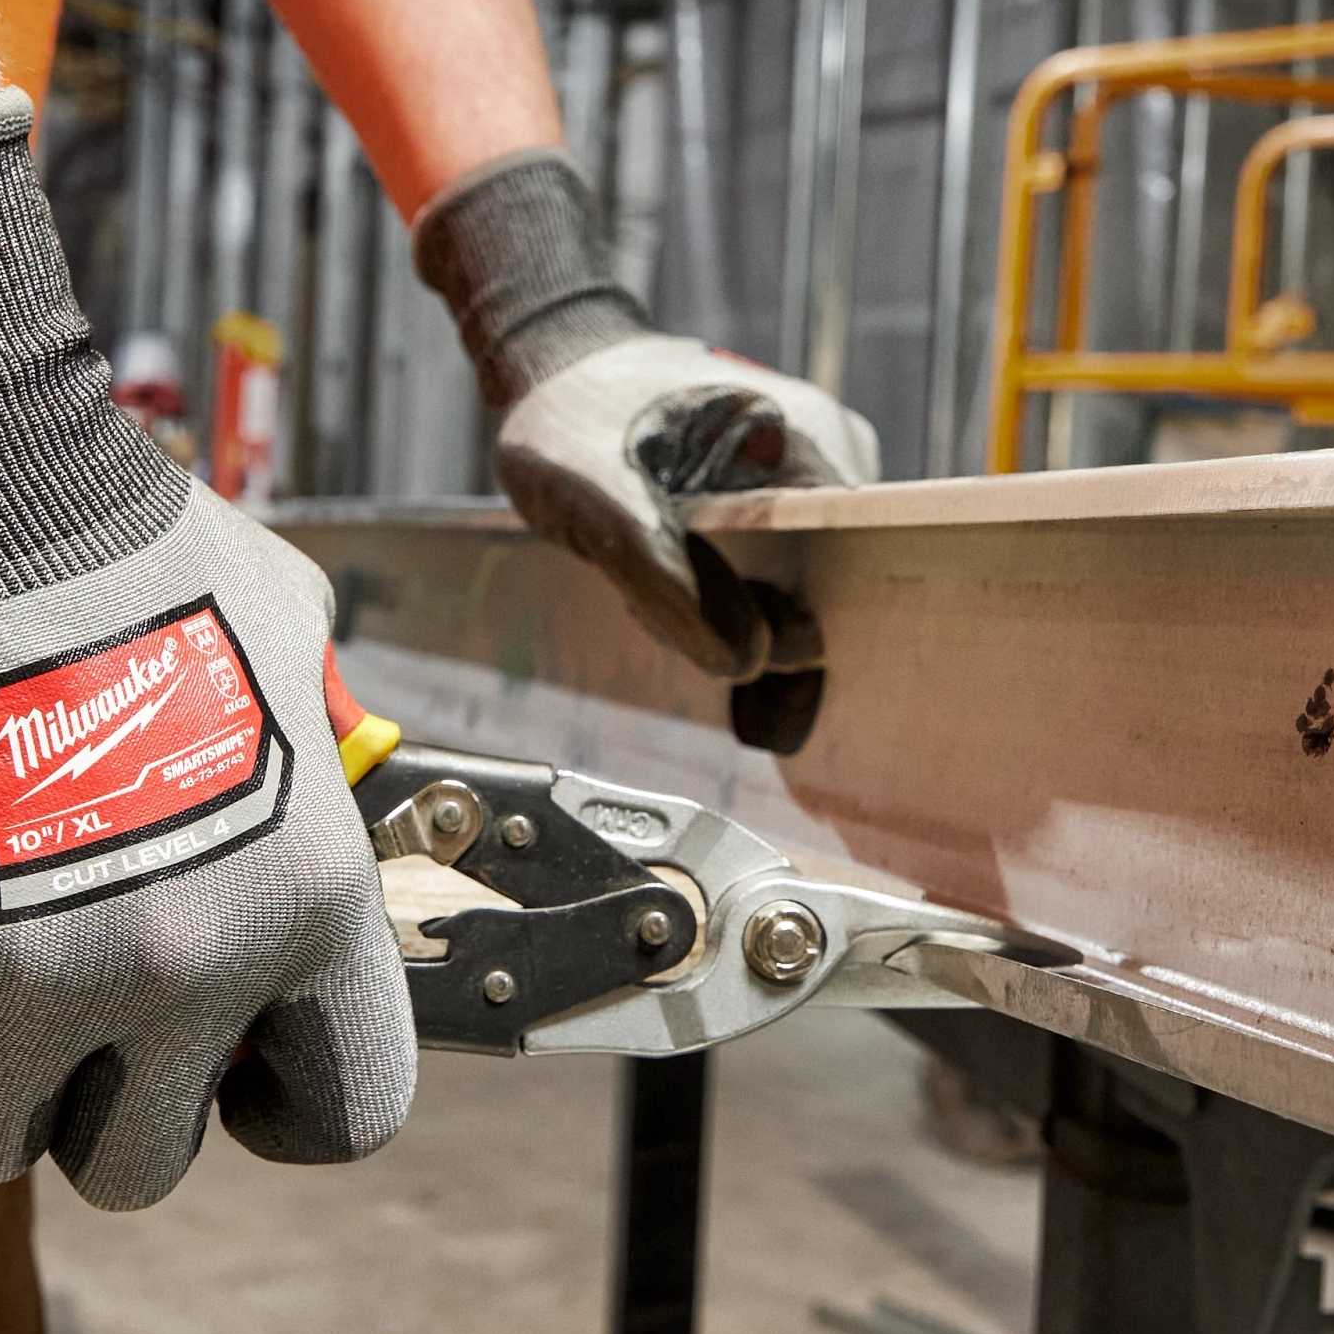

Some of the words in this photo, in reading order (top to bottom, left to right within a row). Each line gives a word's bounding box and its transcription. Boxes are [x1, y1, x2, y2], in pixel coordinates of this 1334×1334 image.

[196, 629, 215, 648] A4
[179, 752, 245, 790] 48-73-8743
[74, 810, 113, 838] XL
[52, 858, 113, 893] CUT
[120, 830, 207, 870] LEVEL
[213, 817, 230, 839] 4
